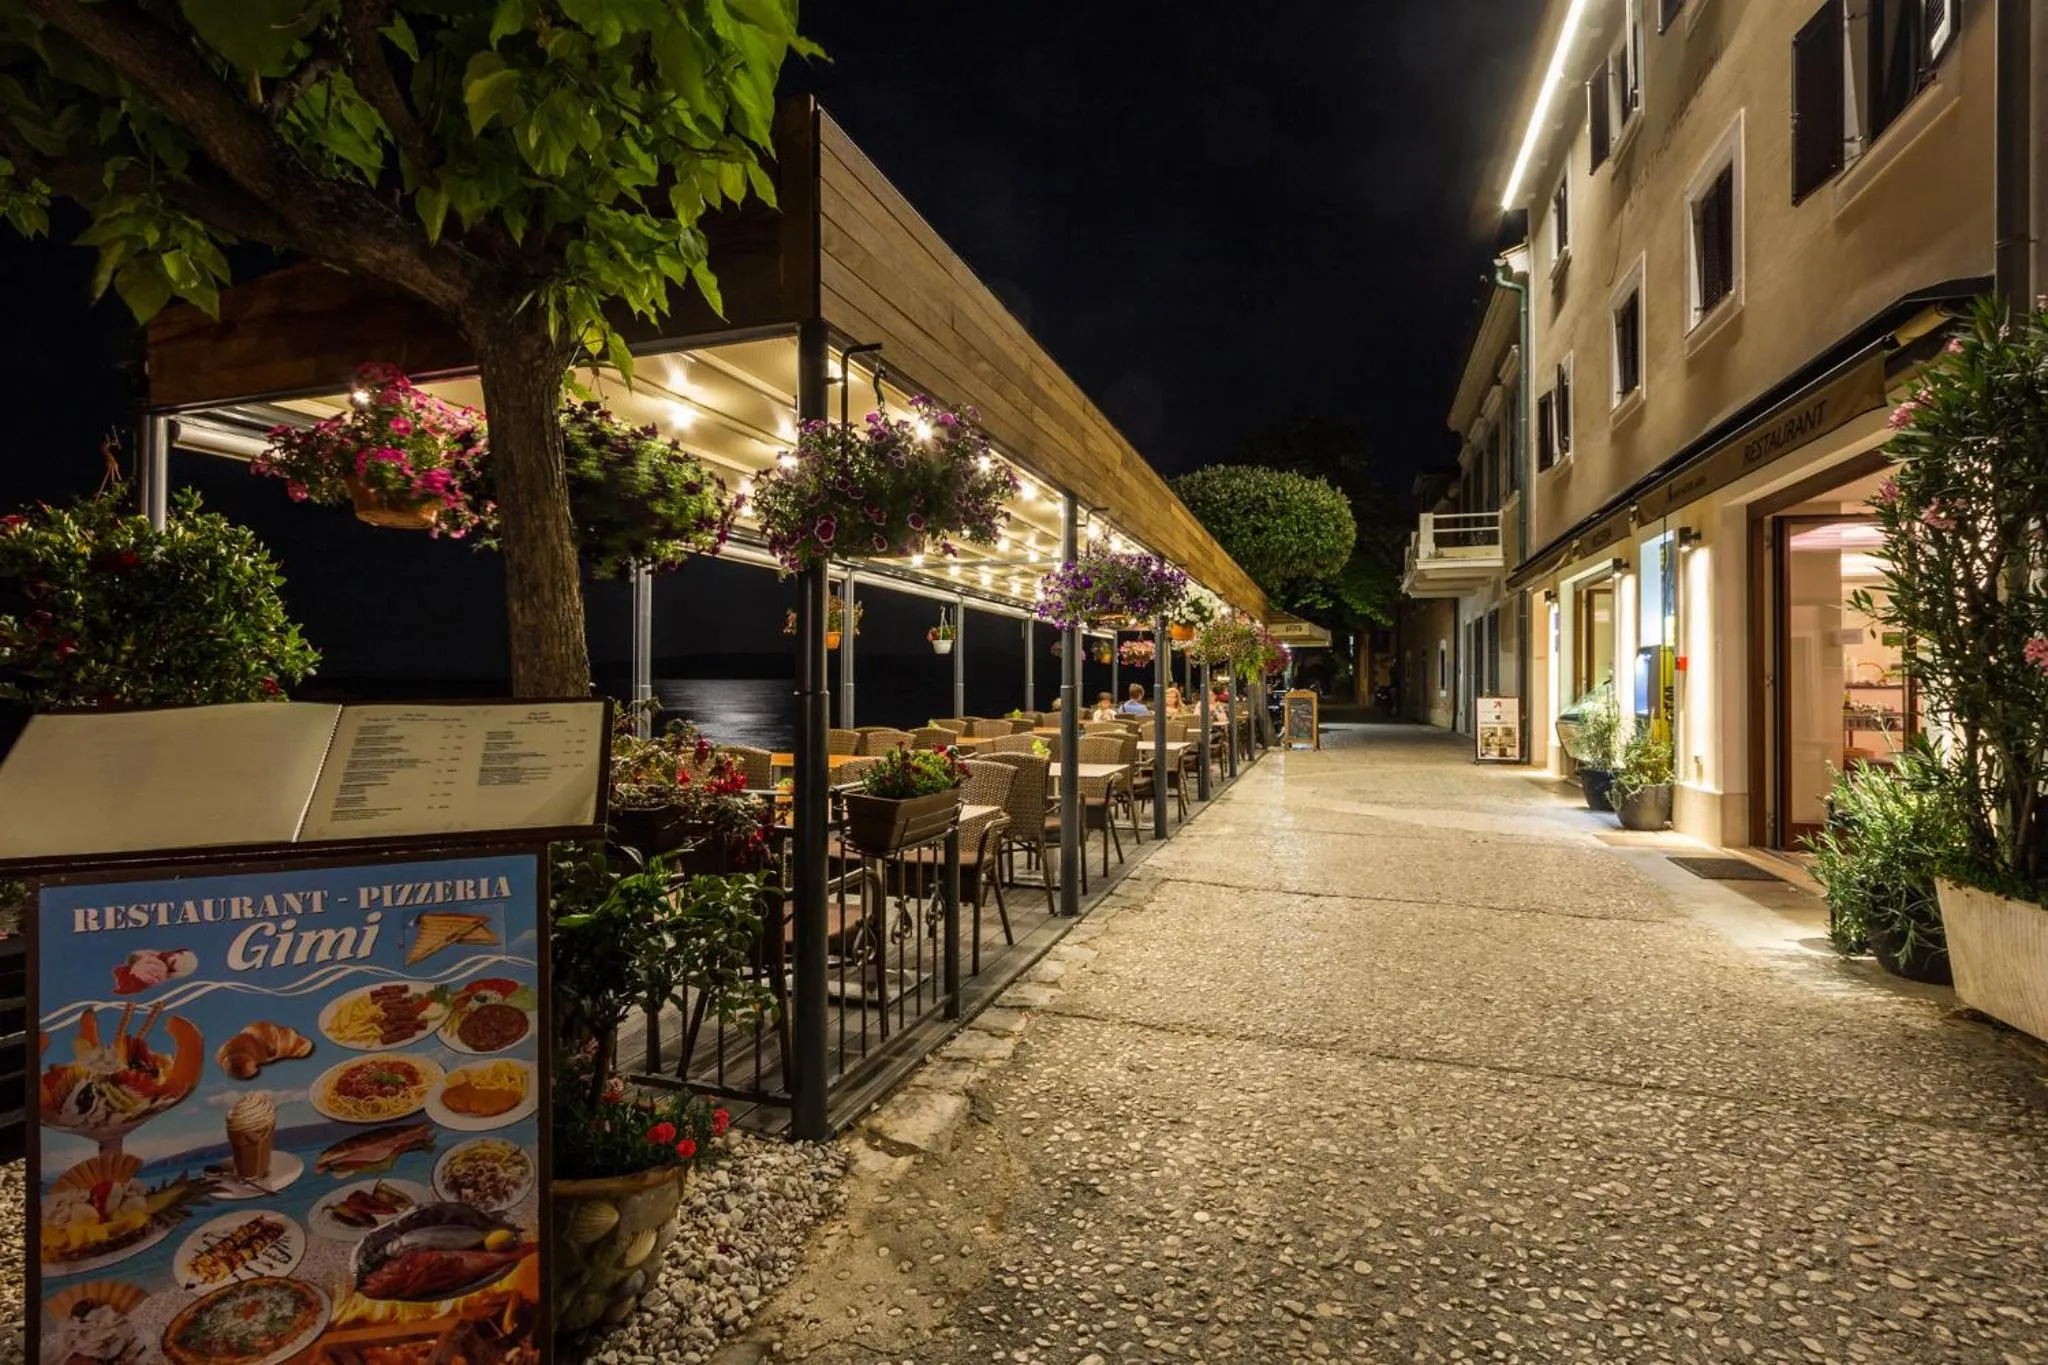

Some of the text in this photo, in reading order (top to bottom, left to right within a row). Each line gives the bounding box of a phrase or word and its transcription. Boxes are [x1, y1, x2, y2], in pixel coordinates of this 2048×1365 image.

[1743, 400, 1827, 466] RESTAURANT
[73, 889, 328, 933] RESTAURANT
[358, 876, 513, 911] PIZZERIA
[226, 911, 382, 972] Gimi
